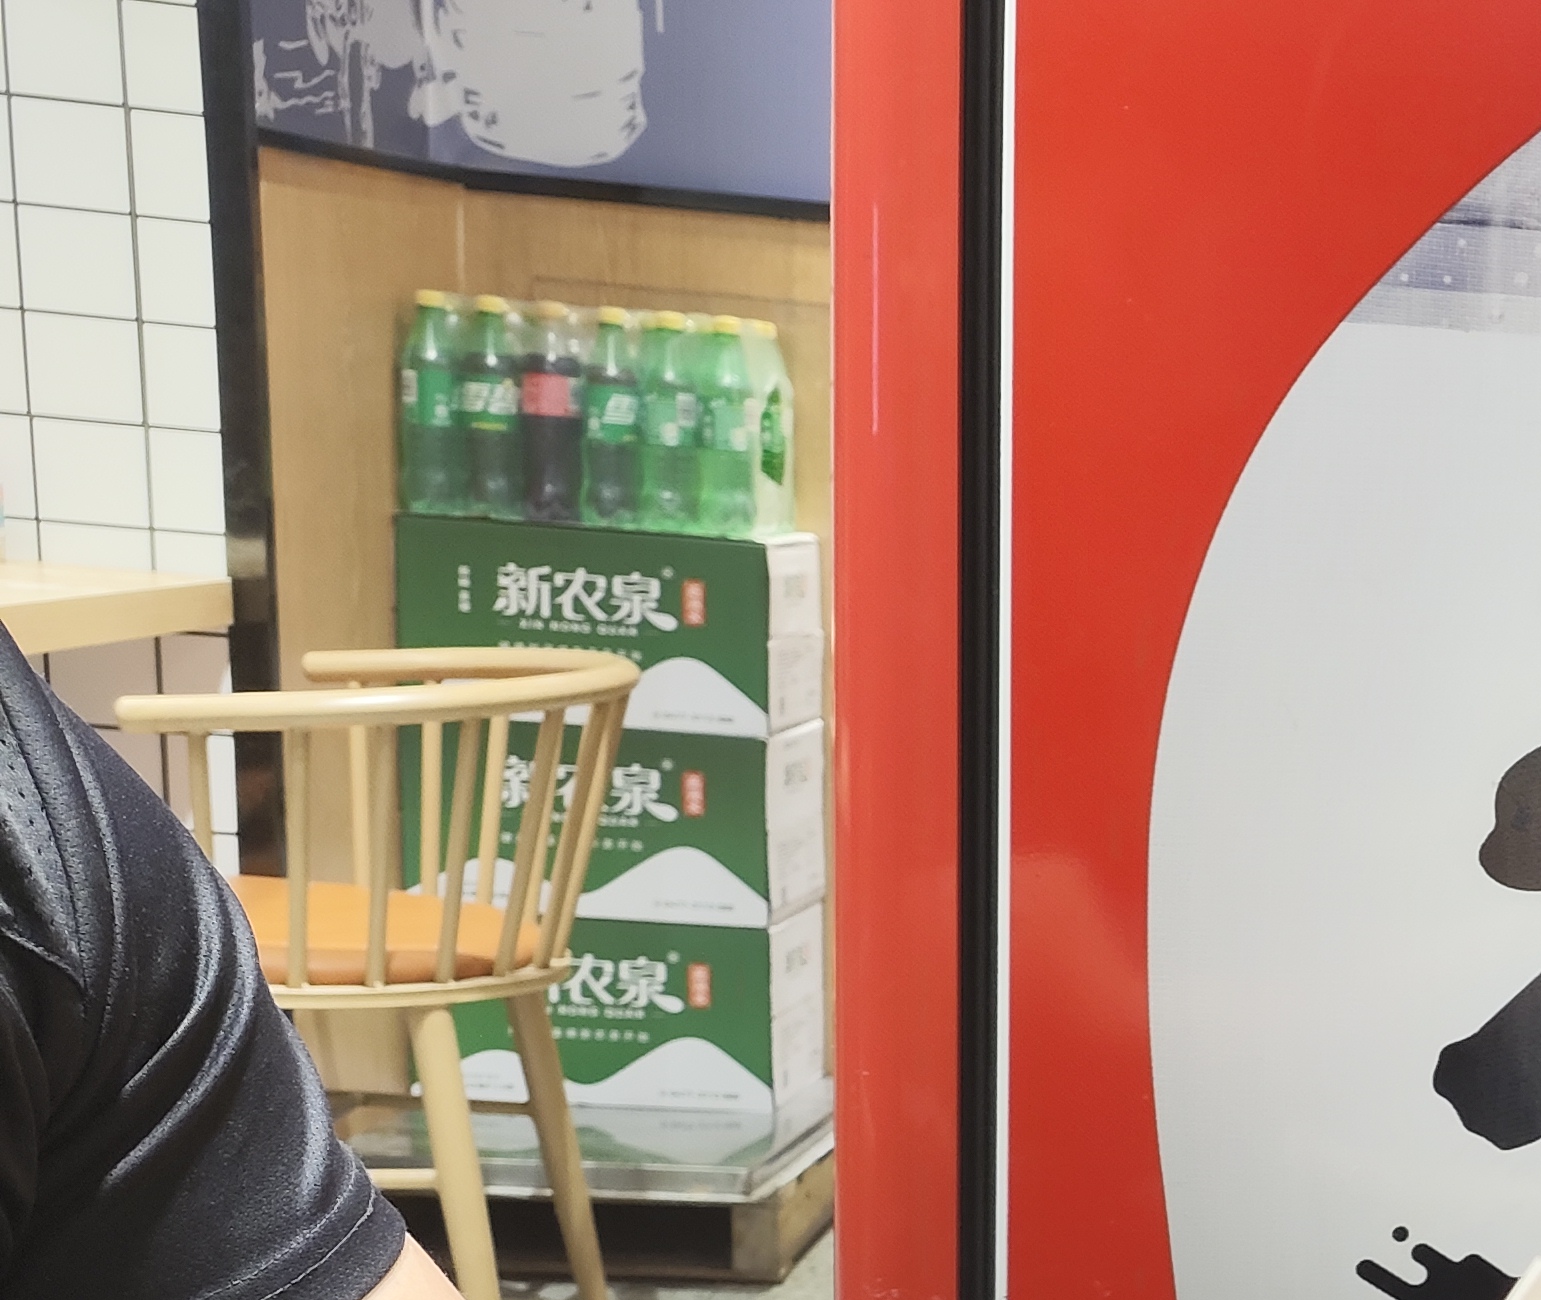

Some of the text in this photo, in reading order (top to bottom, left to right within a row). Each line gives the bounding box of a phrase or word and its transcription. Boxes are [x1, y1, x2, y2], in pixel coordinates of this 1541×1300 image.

[492, 562, 679, 632] 新农泉
[548, 953, 685, 1014] 农泉
